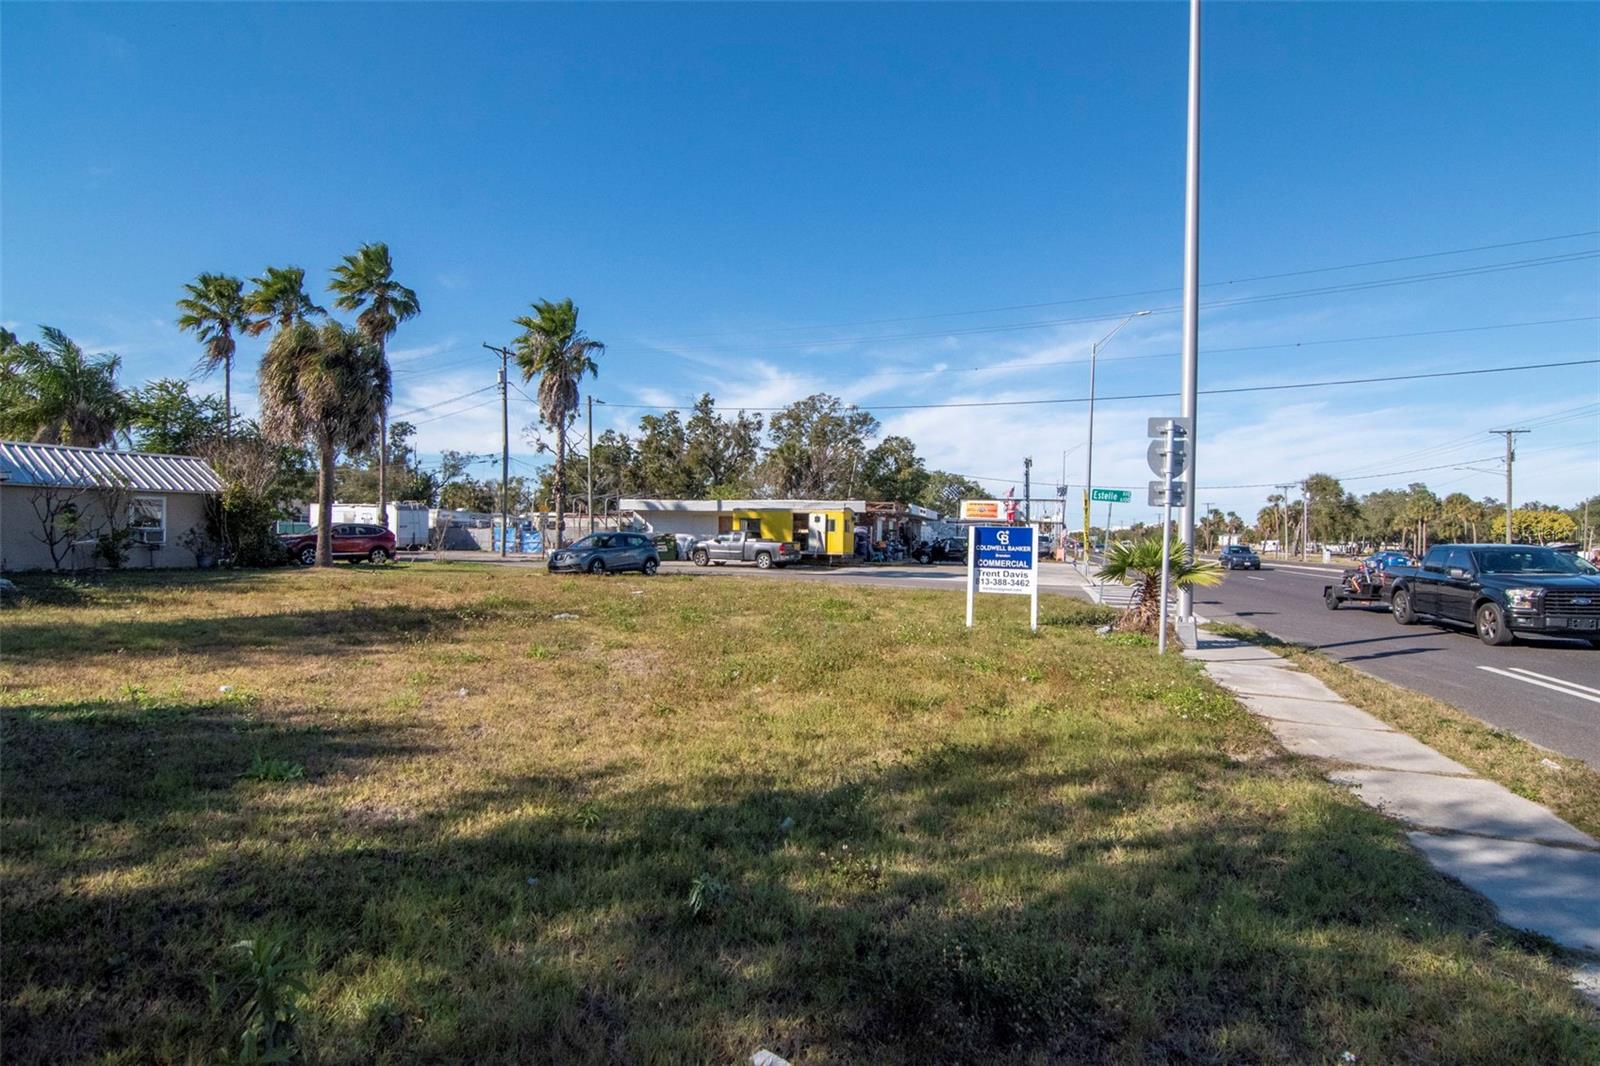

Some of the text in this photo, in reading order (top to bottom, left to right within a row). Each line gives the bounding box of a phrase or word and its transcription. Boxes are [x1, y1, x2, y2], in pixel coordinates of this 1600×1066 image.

[1093, 490, 1118, 500] Estelle
[977, 559, 1029, 568] COMMERCIAL
[977, 569, 1029, 578] Trent Davis
